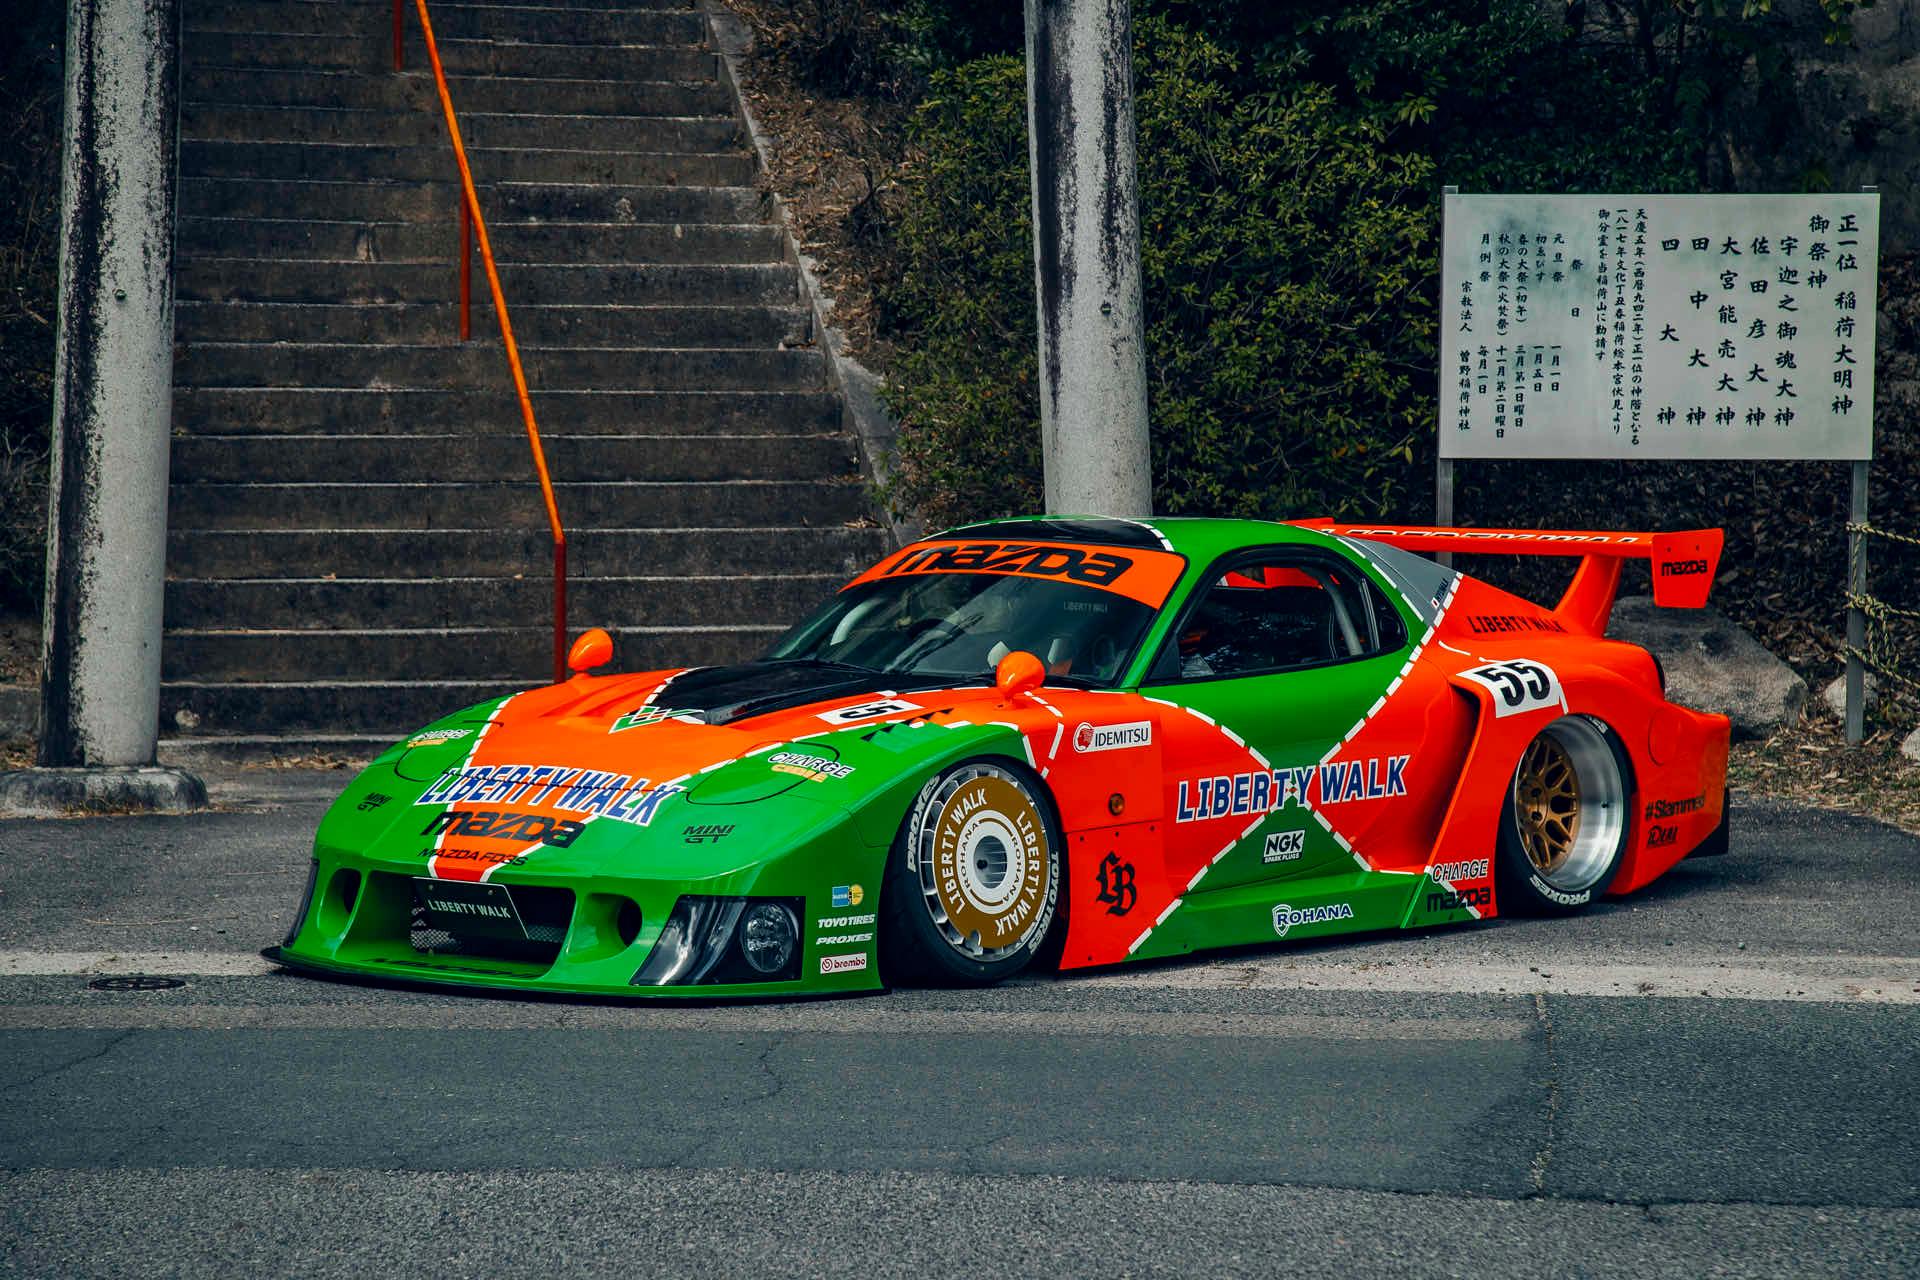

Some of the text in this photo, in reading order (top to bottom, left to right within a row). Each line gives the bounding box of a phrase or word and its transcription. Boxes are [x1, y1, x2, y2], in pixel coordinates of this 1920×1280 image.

[1480, 234, 1491, 282] 月例祭
[1808, 215, 1830, 288] 御祭神
[1460, 281, 1472, 331] 宗教法人
[1551, 234, 1564, 391] 元旦祭 一月一日
[1657, 239, 1679, 424] 四大神
[1686, 237, 1709, 425] 田中大神
[1716, 236, 1741, 425] 大宮能売大神
[1746, 236, 1770, 426] 佐田彦大神
[1774, 236, 1800, 426] 宇迦之御魂大神
[1533, 346, 1544, 391] 一月五日
[1661, 560, 1708, 577] mazda
[1475, 661, 1550, 707] 55
[1095, 727, 1149, 747] IDEMITSU
[768, 752, 856, 779] CHARGE
[1176, 754, 1411, 823] LIBERTY WALK
[413, 766, 688, 827] LIBERTY WALK
[420, 811, 586, 849] mazda
[906, 775, 941, 873] PROXES
[1265, 832, 1303, 856] NGK
[417, 848, 480, 861] MAZDA
[941, 788, 988, 915] LIBERTY WALK
[995, 810, 1041, 937] LIBERTY WALK
[1432, 859, 1489, 883] CHARGE
[427, 900, 512, 919] LIBERTY WALK
[1276, 904, 1353, 927] ROHANA
[816, 933, 873, 945] PROXES
[834, 957, 866, 969] brembo
